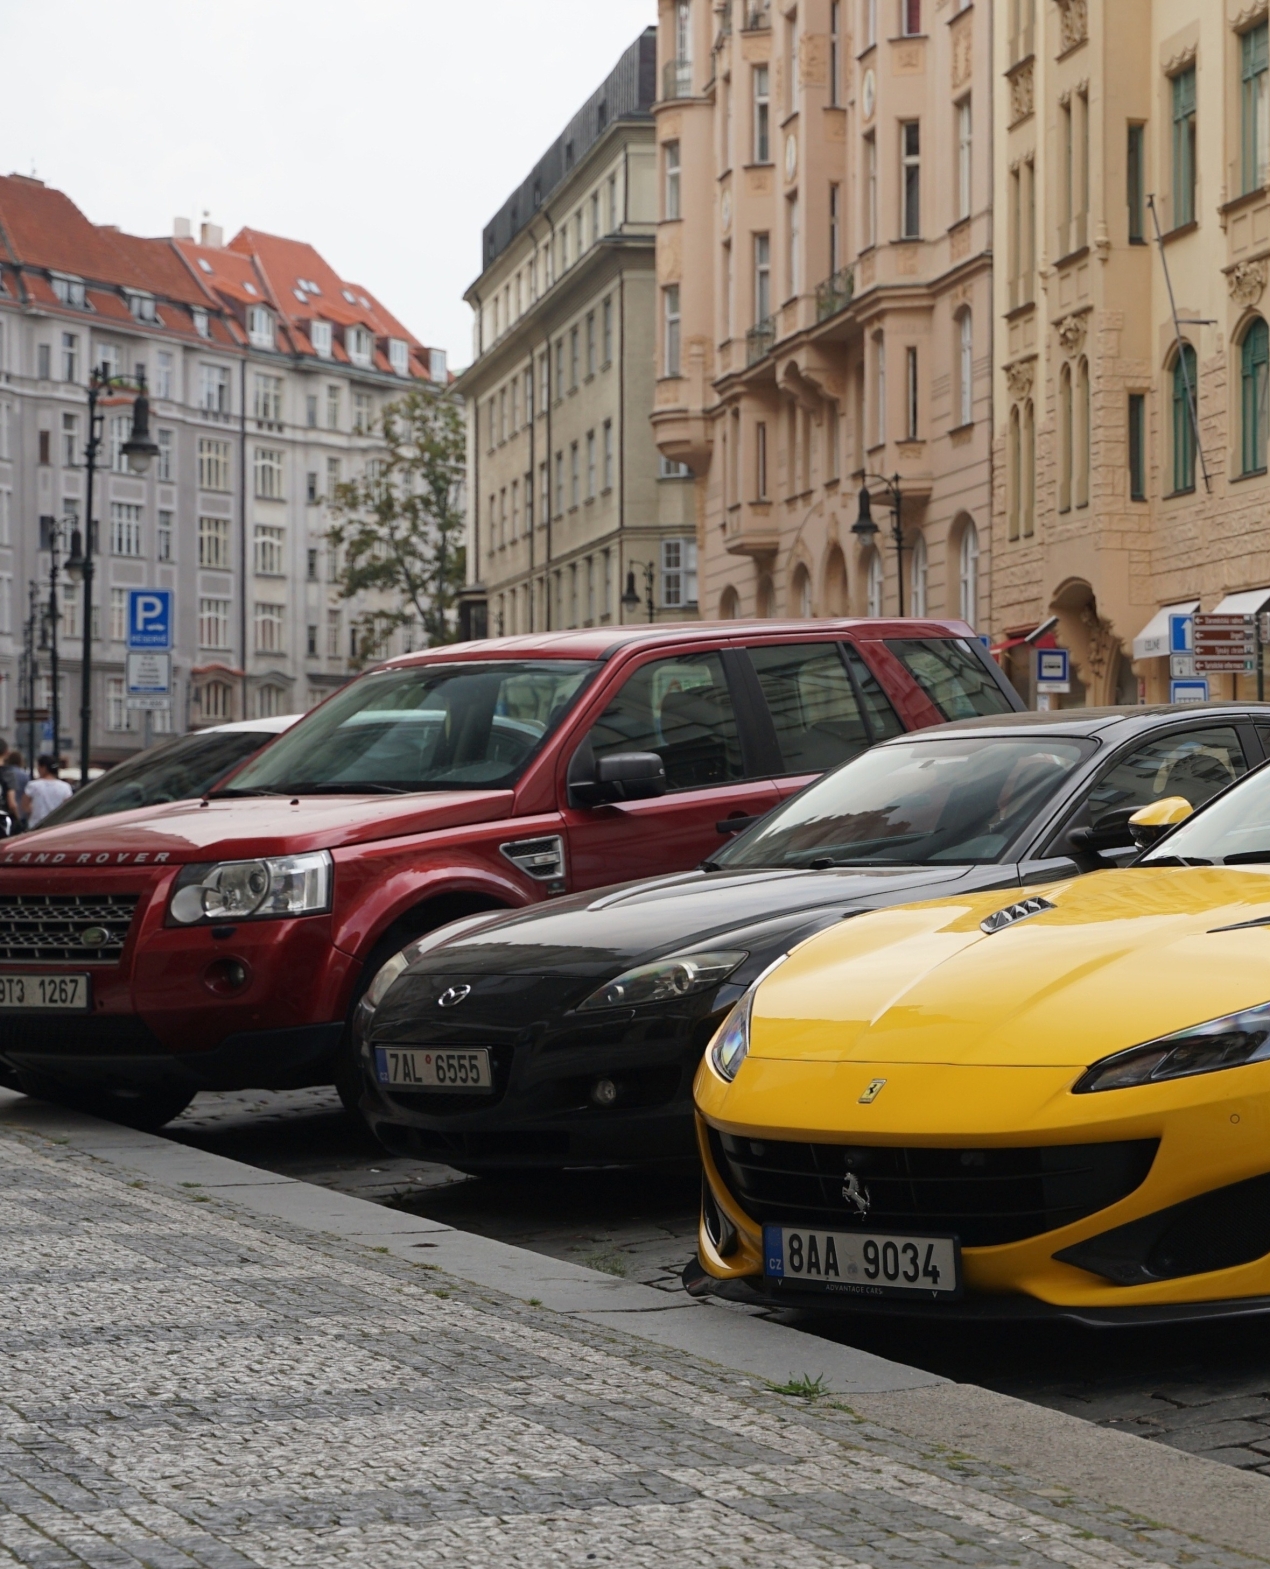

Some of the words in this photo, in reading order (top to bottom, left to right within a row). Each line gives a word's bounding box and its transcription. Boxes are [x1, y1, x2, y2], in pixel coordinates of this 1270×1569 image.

[136, 595, 164, 631] P
[4, 852, 66, 863] LAND
[76, 852, 170, 863] ROVER
[38, 978, 79, 1004] 1267
[389, 1053, 423, 1083] 7AL
[435, 1054, 480, 1084] 6555
[769, 1257, 782, 1271] CZ
[788, 1233, 840, 1277] 8AA
[863, 1239, 941, 1285] 9034
[825, 1283, 865, 1294] ADVANTAGE
